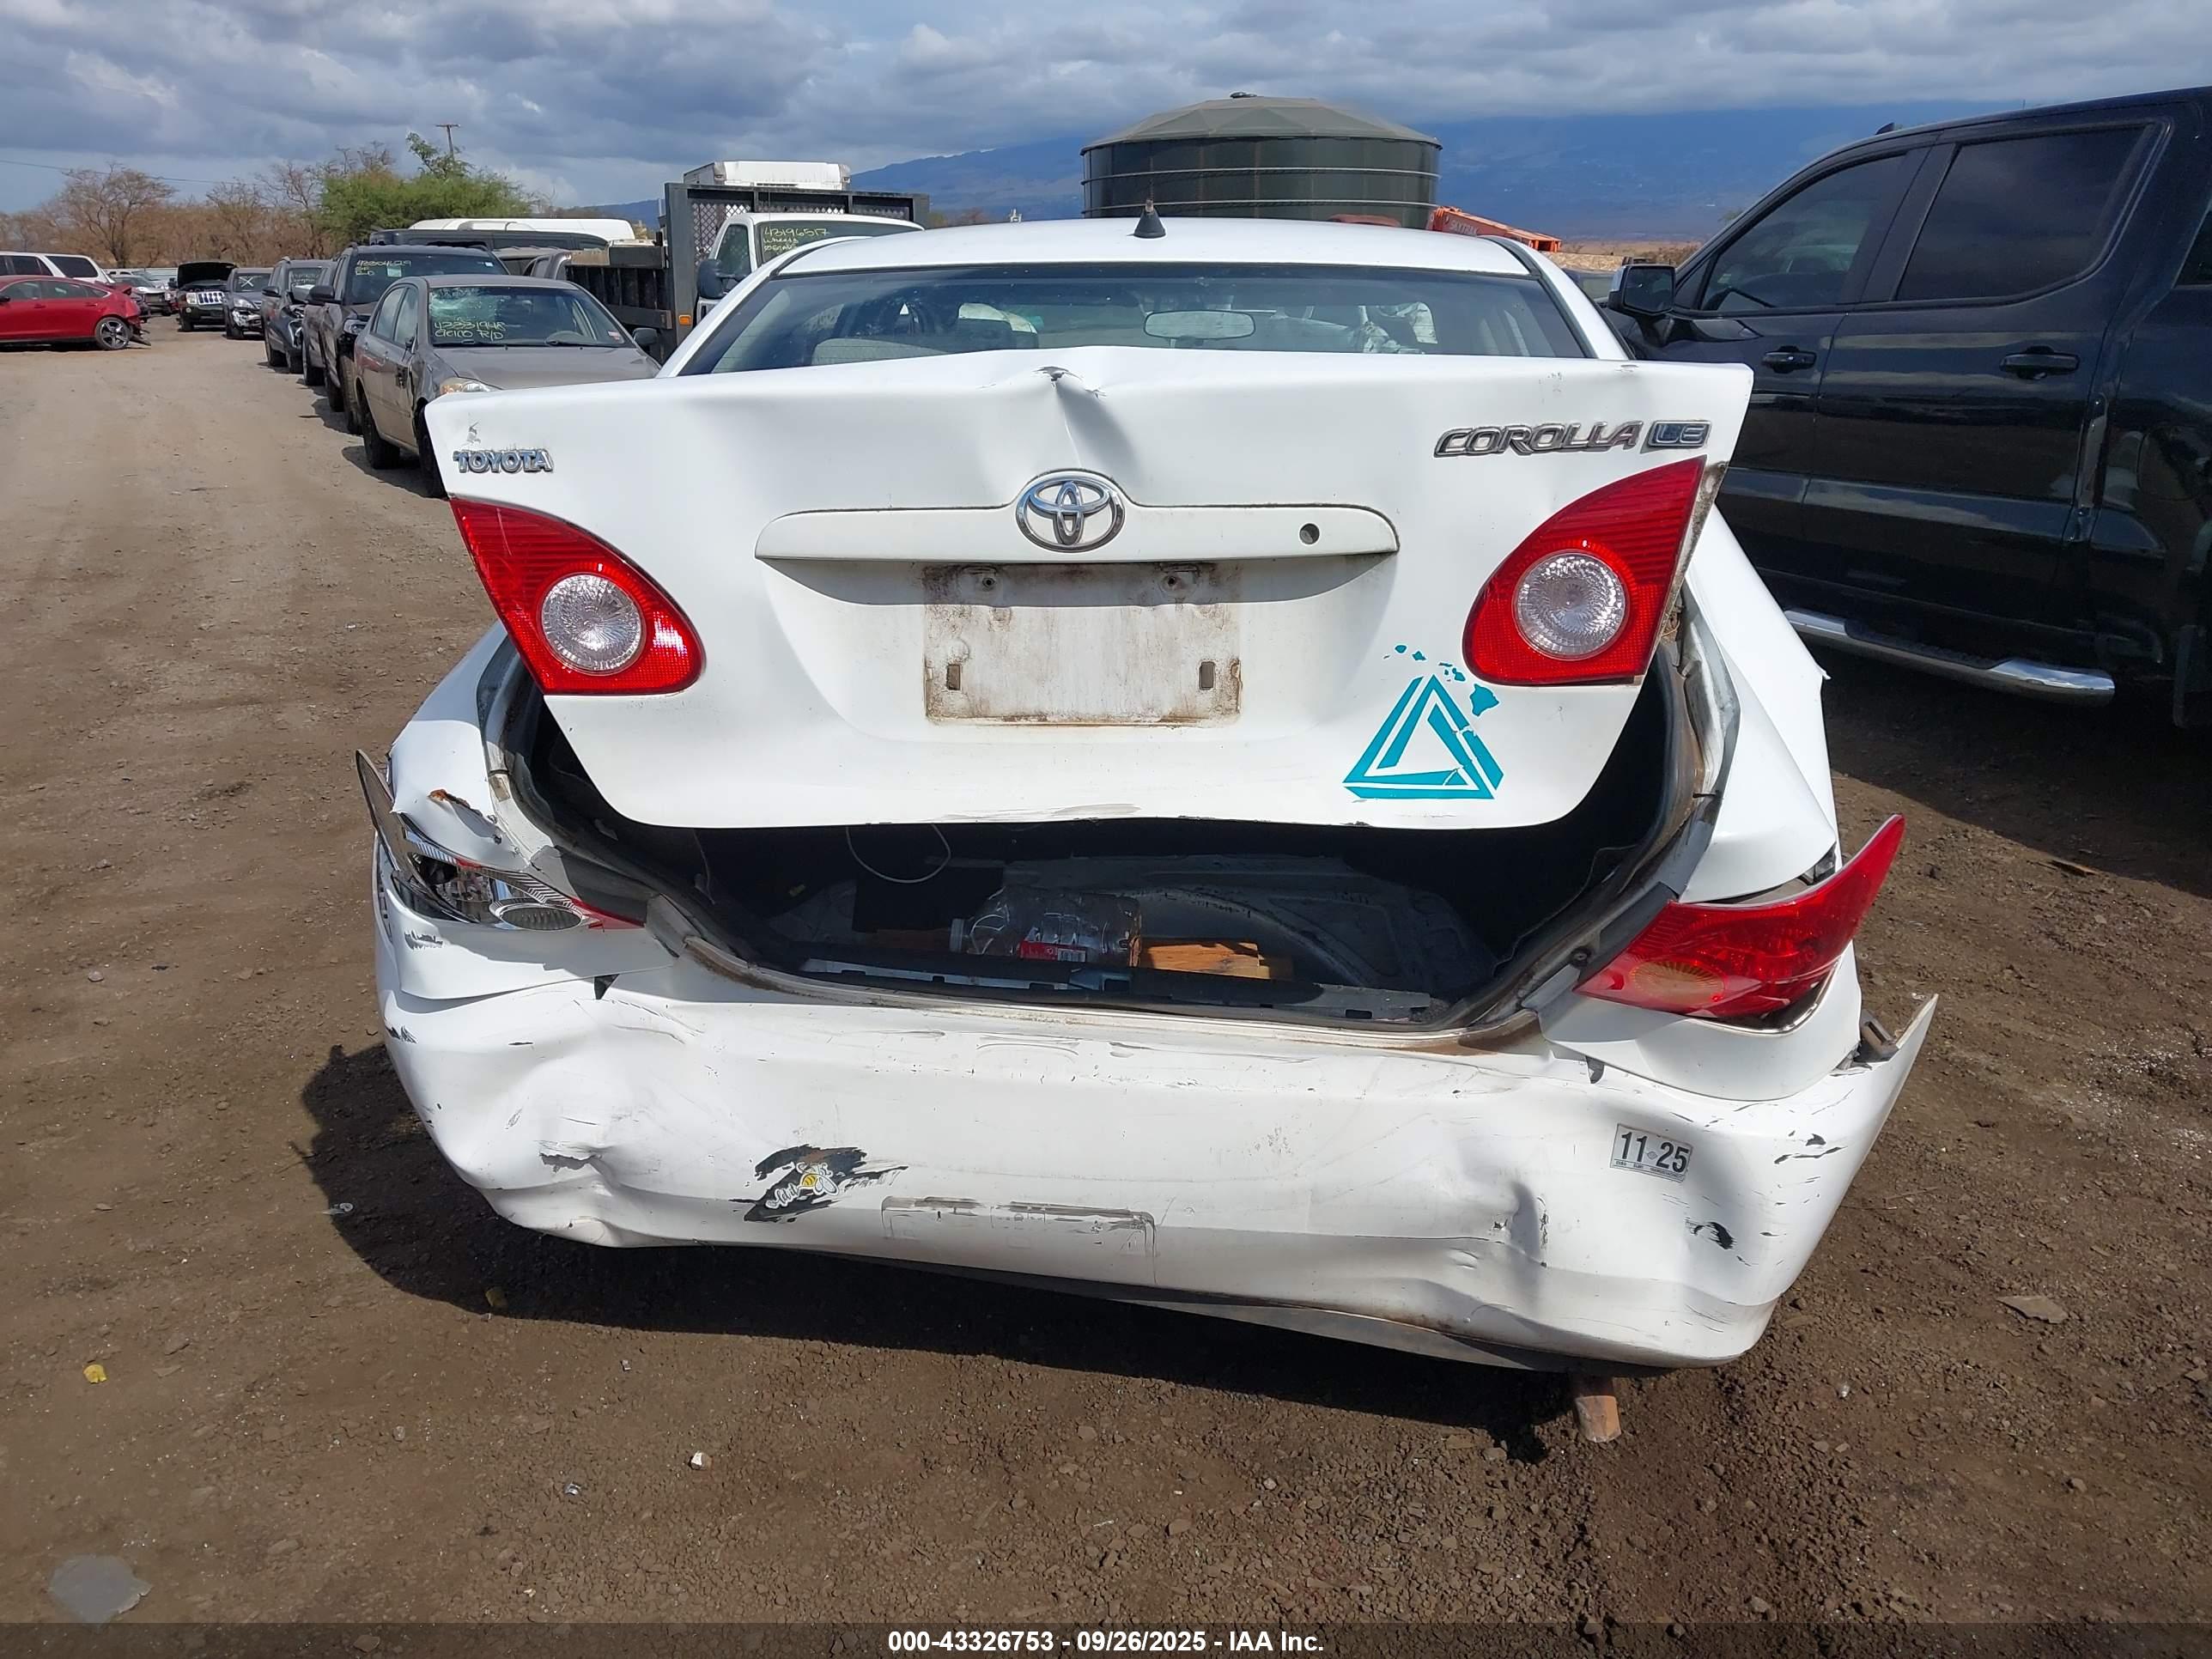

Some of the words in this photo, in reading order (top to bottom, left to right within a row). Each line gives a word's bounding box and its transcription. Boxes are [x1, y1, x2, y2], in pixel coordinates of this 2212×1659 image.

[764, 226, 830, 237] 43196517
[1433, 420, 1644, 457] COROLLA
[1650, 423, 1707, 446] LE
[453, 448, 554, 473] TOYOTA
